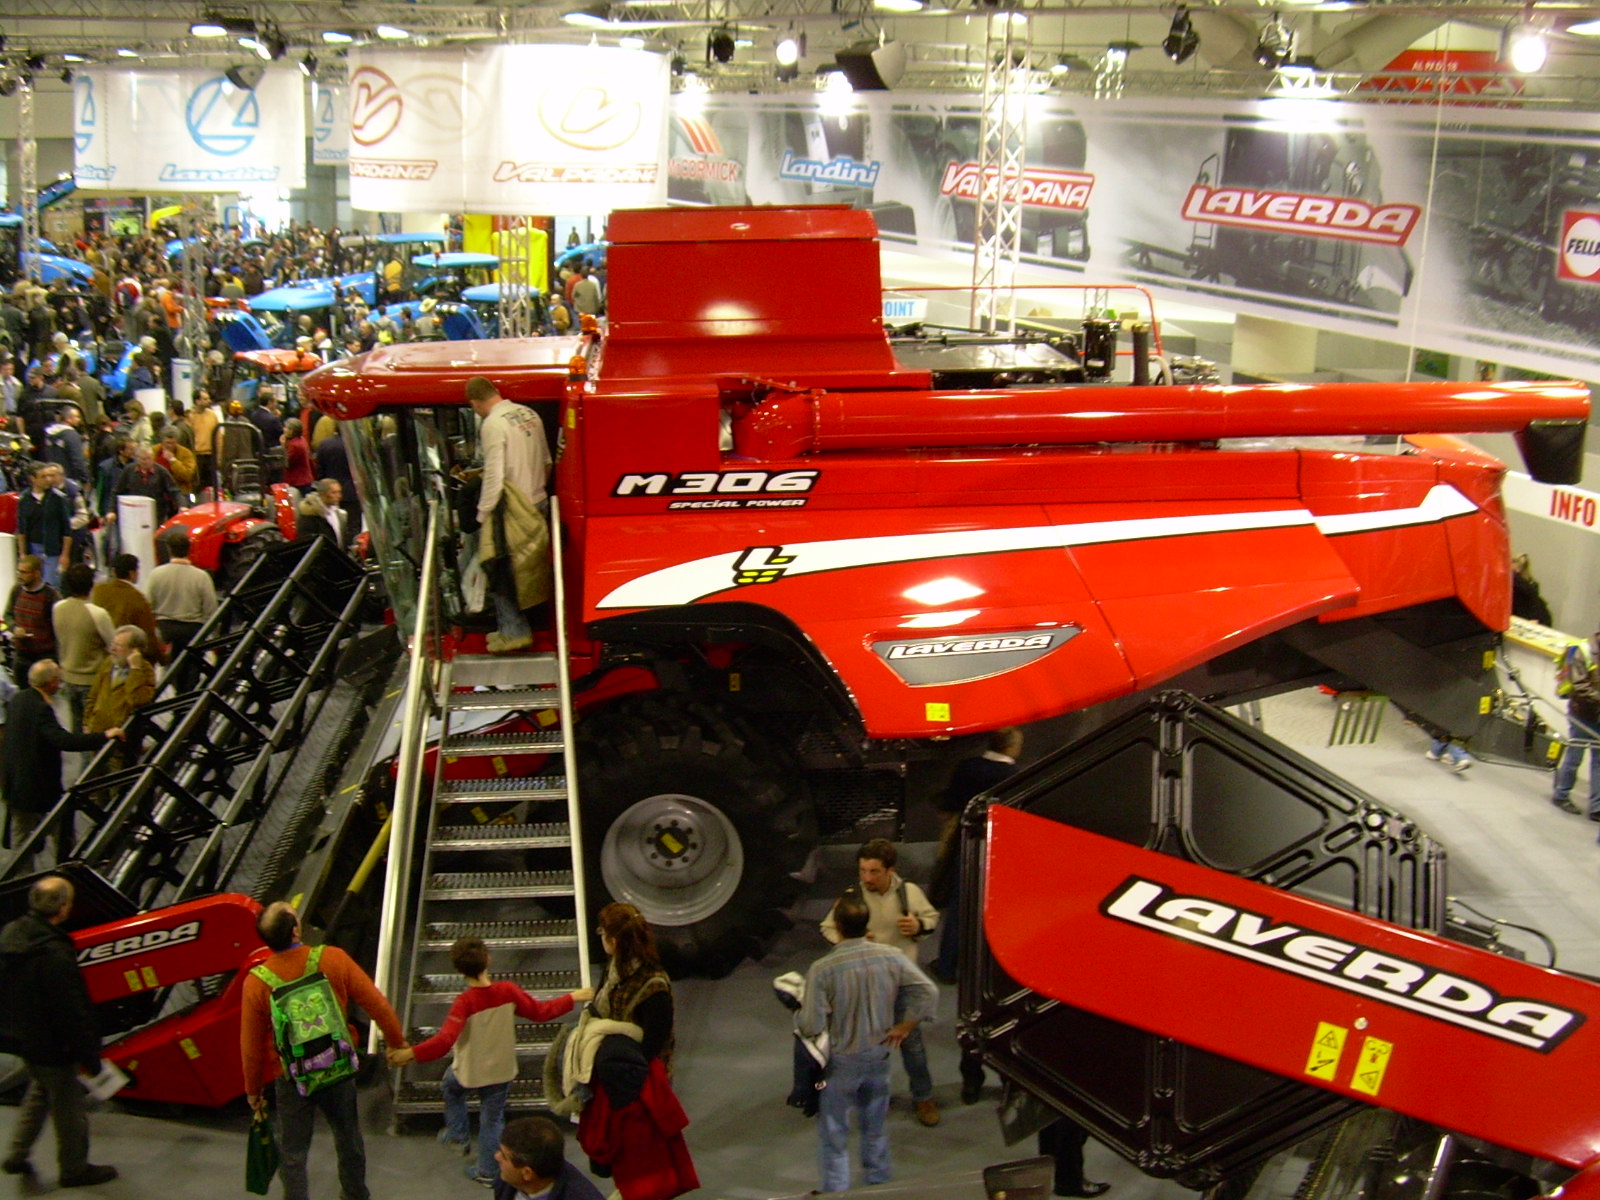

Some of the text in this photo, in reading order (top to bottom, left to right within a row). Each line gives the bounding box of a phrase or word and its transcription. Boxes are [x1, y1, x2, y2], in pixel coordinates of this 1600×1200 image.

[781, 152, 878, 185] Landini
[1183, 186, 1419, 244] LAVERDA
[884, 300, 915, 317] OINT
[613, 470, 820, 496] M 306
[745, 498, 806, 508] POWER
[1550, 489, 1596, 527] INFO
[888, 634, 1054, 660] LAVERDA
[77, 921, 200, 967] VERDA
[1105, 879, 1577, 1049] LAVERDA
